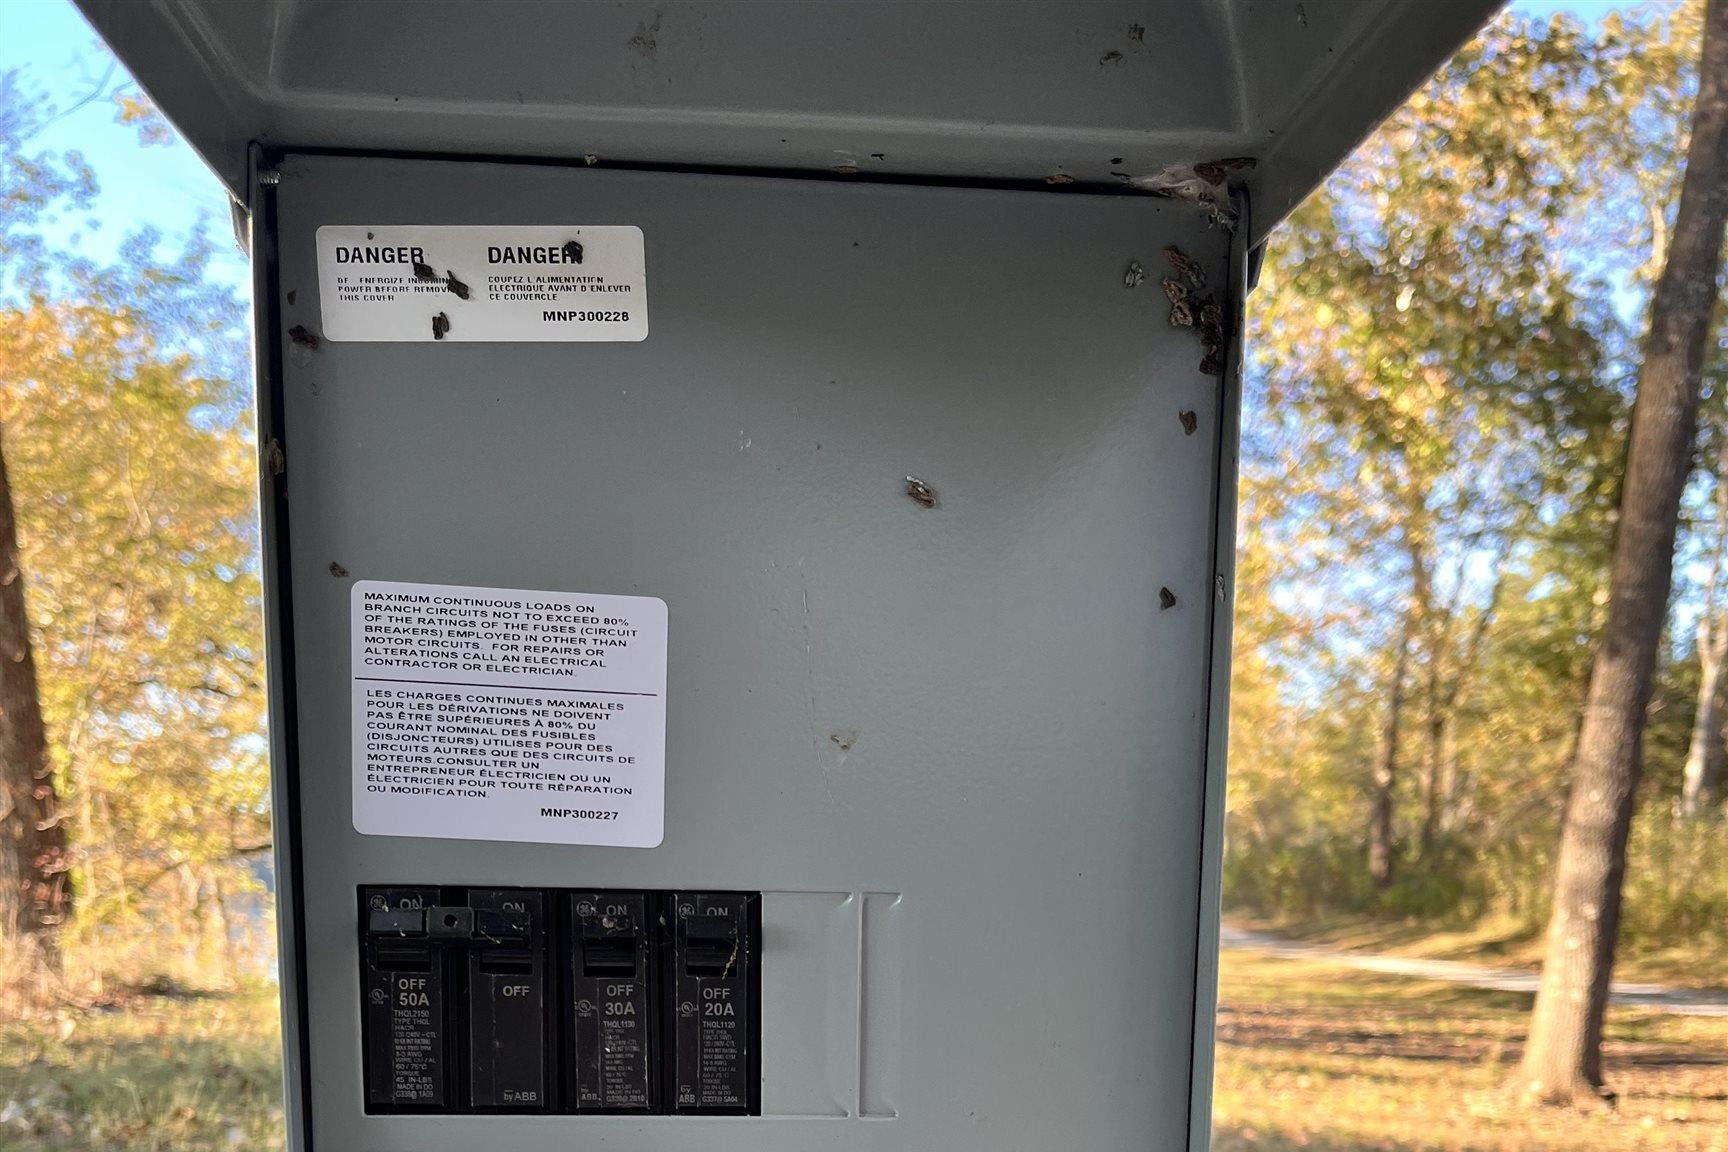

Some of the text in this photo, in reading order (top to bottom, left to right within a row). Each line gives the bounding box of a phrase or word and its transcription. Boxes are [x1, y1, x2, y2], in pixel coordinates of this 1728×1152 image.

[335, 246, 425, 265] DANGER
[543, 311, 629, 322] MNP300228
[365, 592, 594, 613] MAXIMUM CONTINUOUS LOADS ON
[365, 603, 629, 626] BRANCH CIRCUITS NOT TO EXCEED 80%
[364, 614, 636, 637] OF THE RATINGS OF THE FUSES (CIRCUIT
[365, 625, 443, 638] BREAKERS)
[448, 630, 521, 641] EMPLOYED
[542, 636, 587, 645] OTHER
[592, 638, 626, 647] THAN
[365, 636, 413, 646] MOTOR
[492, 643, 519, 652] FOR
[524, 645, 581, 655] REPAIRS
[585, 649, 604, 657] OR
[364, 647, 458, 659] ALTERATIONS
[463, 653, 497, 661] CALL
[525, 656, 606, 667] ELECTRICAL
[364, 658, 458, 670] CONTRACTOR
[462, 663, 481, 671] OR
[367, 690, 624, 710] LES CHARGES CONTINUES MAXIMALES
[367, 700, 610, 720] POUR LES DÉRIVATIONS NE DOIVENT
[367, 711, 393, 719] PAS
[398, 711, 432, 721] ÊTRE
[437, 715, 530, 726] SUPÉRIEURES
[548, 721, 573, 729] 80%
[578, 722, 595, 730] DU
[367, 722, 595, 741] COURANT NOMINAL DES FUSIBLES
[367, 732, 479, 746] (DISJONCTEURS)
[546, 742, 582, 750] POUR
[587, 744, 613, 752] DES
[367, 743, 634, 764] CIRCUITS AUTRES QUE DES CIRCUITS DE
[437, 757, 517, 768] CONSULTER
[522, 761, 539, 769] UN
[367, 764, 475, 776] ENTREPRENEUR
[480, 769, 565, 781] ÉLECTRICIEN
[367, 773, 632, 795] ÉLECTRICIEN POUR TOUTE RÉPARATION
[541, 808, 618, 820] MNP300227
[399, 898, 423, 909] ON
[606, 905, 627, 916] ON
[706, 907, 729, 916] ON
[398, 978, 427, 990] OFF
[502, 985, 530, 997] OFF
[606, 984, 634, 997] OFF
[399, 992, 430, 1006] 50A
[702, 988, 731, 1000] OFF
[605, 1001, 636, 1016] 30A
[705, 1002, 735, 1016] 20A
[514, 1091, 537, 1101] ABB
[678, 1094, 695, 1104] ABB
